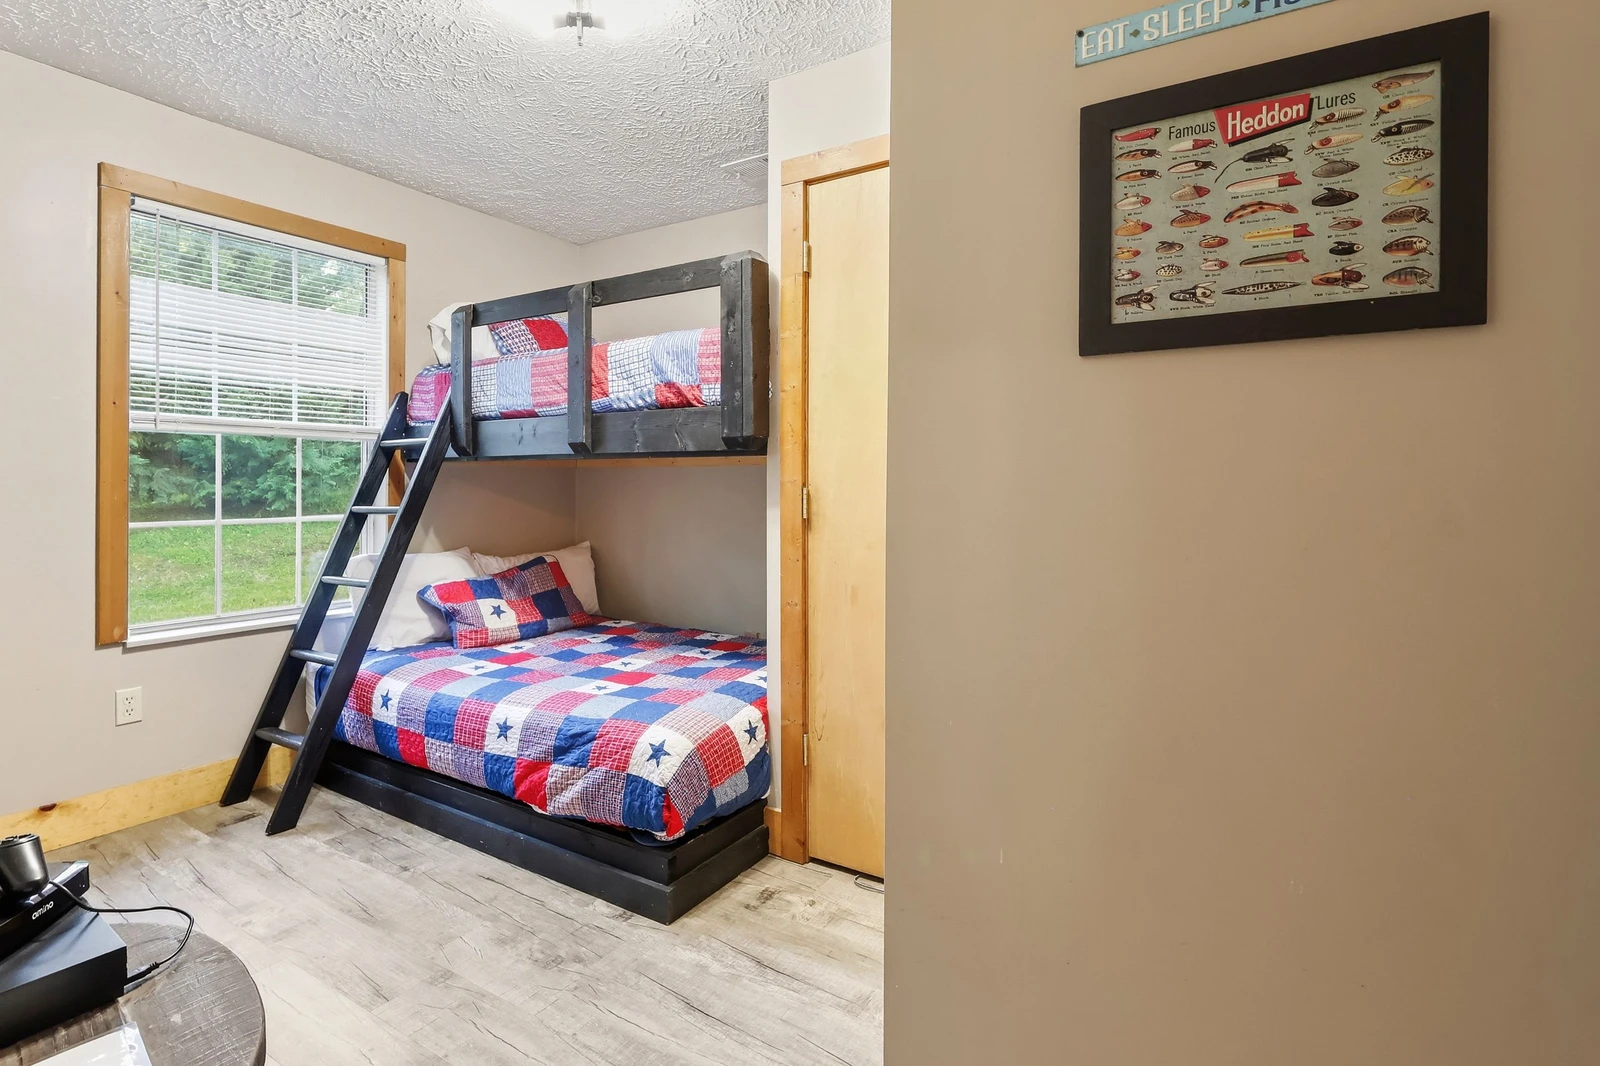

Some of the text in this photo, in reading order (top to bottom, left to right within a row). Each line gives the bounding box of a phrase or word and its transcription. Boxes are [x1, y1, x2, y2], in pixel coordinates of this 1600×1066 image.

[1082, 0, 1233, 59] EAT SLEEP
[1168, 121, 1216, 141] Famous
[1227, 102, 1304, 140] Heddon
[1317, 92, 1356, 110] Lures
[31, 900, 54, 920] amino
